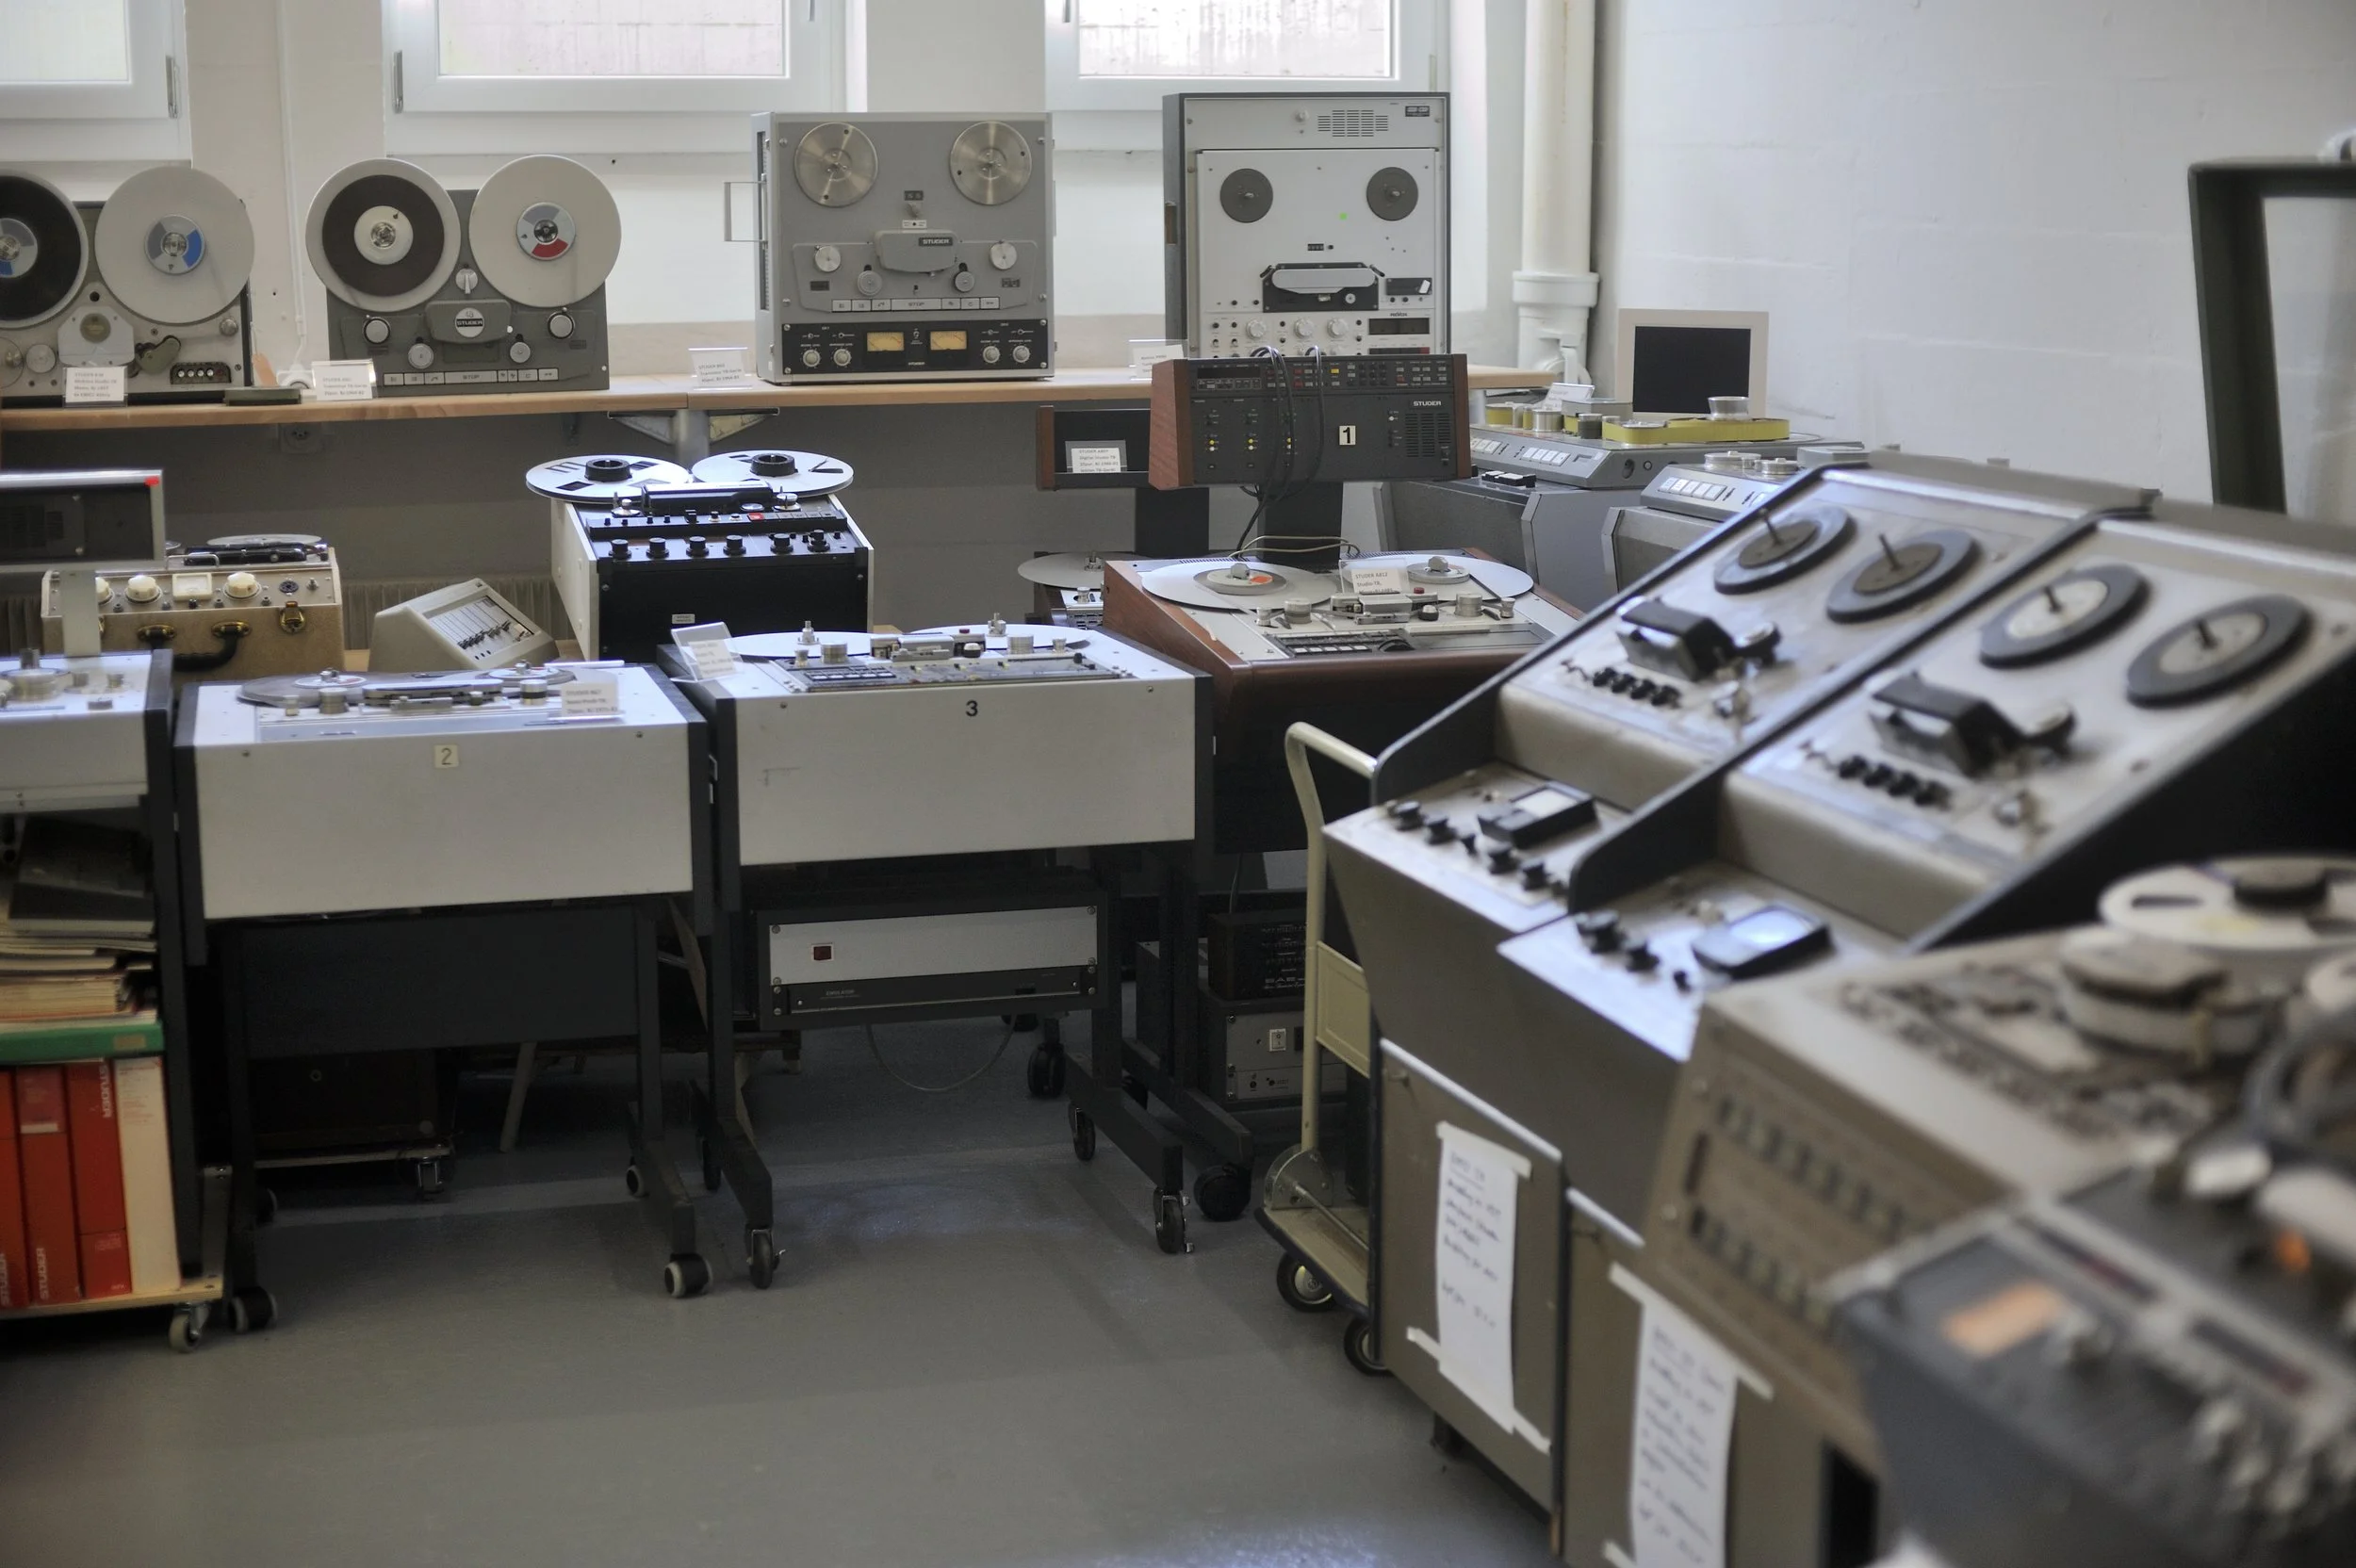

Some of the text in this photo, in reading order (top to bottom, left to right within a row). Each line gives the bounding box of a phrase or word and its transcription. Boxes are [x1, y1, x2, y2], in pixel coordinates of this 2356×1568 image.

[1343, 427, 1350, 444] 1
[966, 700, 978, 716] 3
[441, 747, 452, 765] 2
[99, 1064, 112, 1118] STUDER
[36, 1248, 49, 1299] STUDER
